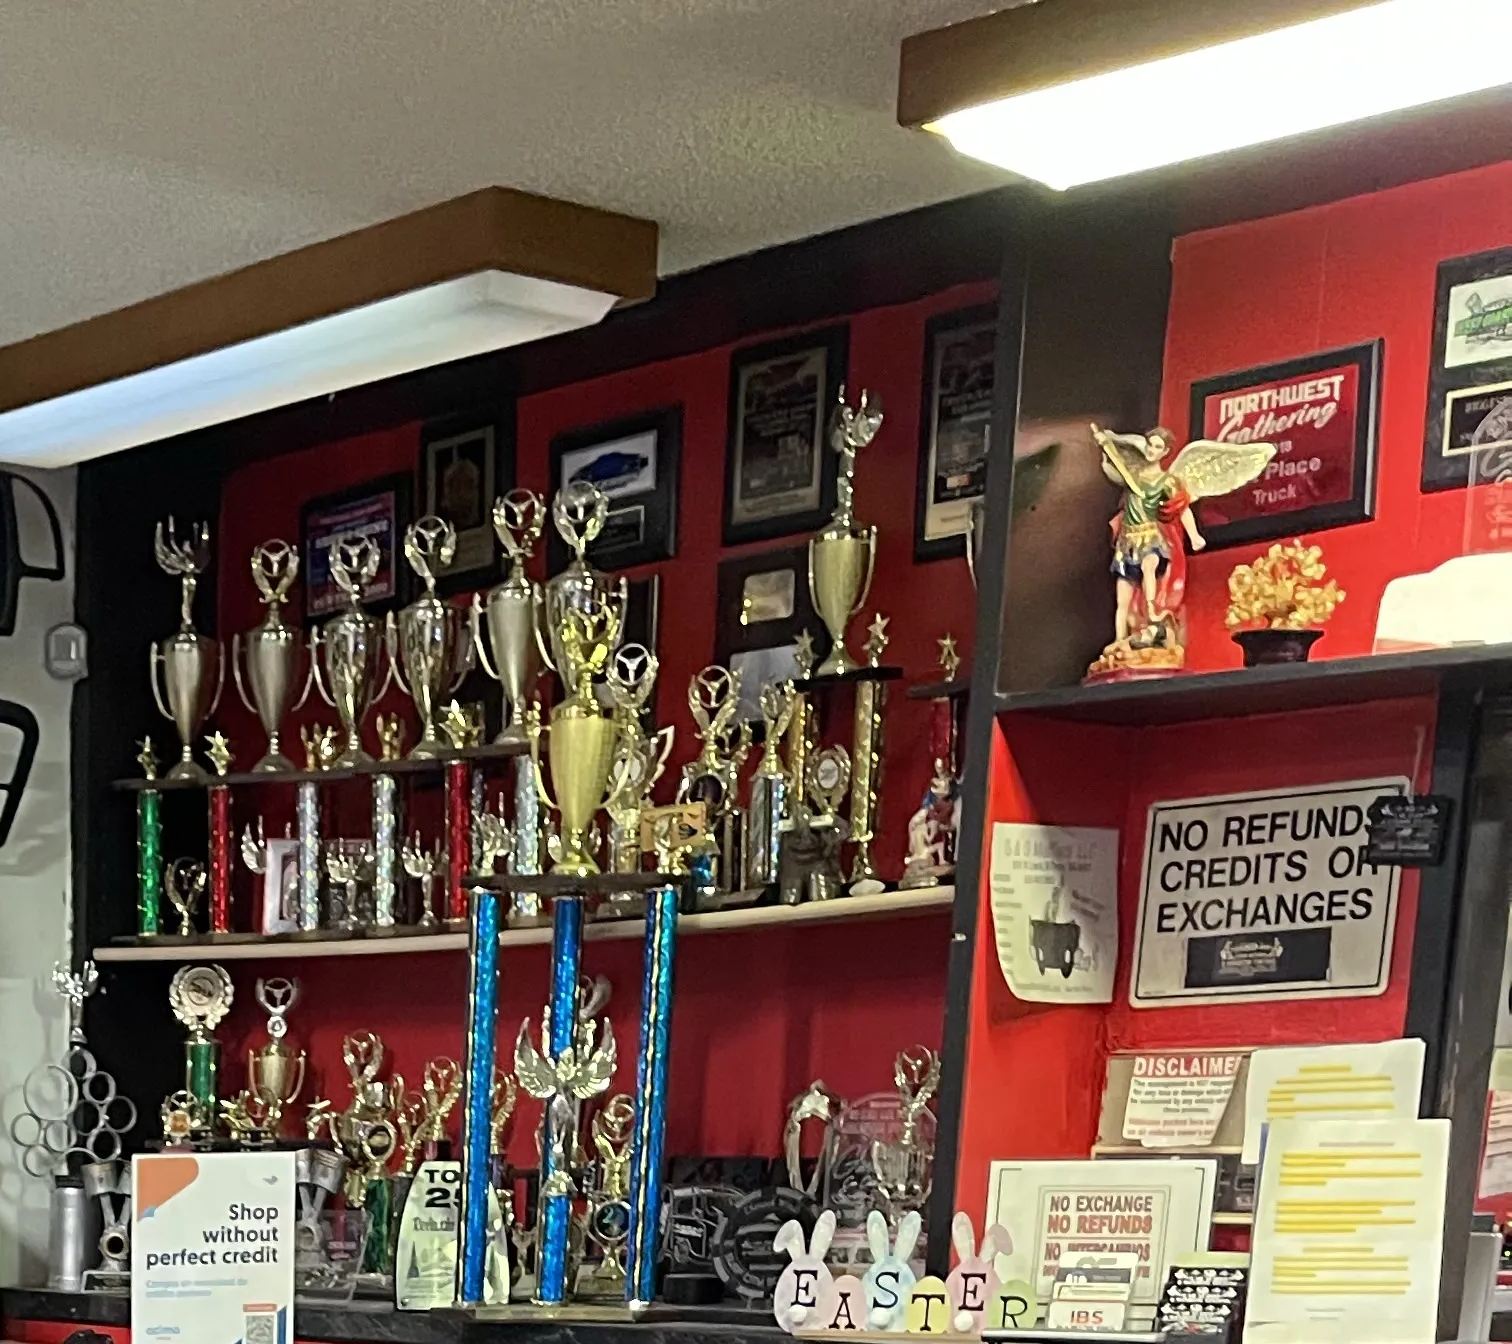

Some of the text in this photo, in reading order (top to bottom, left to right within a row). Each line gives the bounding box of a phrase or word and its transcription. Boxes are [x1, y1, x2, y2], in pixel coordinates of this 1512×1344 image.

[1219, 374, 1345, 424] NORTHWEST
[1217, 401, 1337, 443] Gathering
[1264, 457, 1322, 480] Place
[1252, 484, 1297, 505] Truck
[1159, 804, 1368, 853] NO REFUND
[1160, 845, 1378, 892] CREDITS OR
[1157, 888, 1374, 933] EXCHANGES
[424, 1169, 461, 1184] TO
[229, 1202, 279, 1224] Shop
[1050, 1195, 1153, 1212] NO EXCHANGE
[202, 1225, 279, 1243] without
[1047, 1214, 1153, 1234] NO REFUNDS
[146, 1246, 278, 1270] perfect credit
